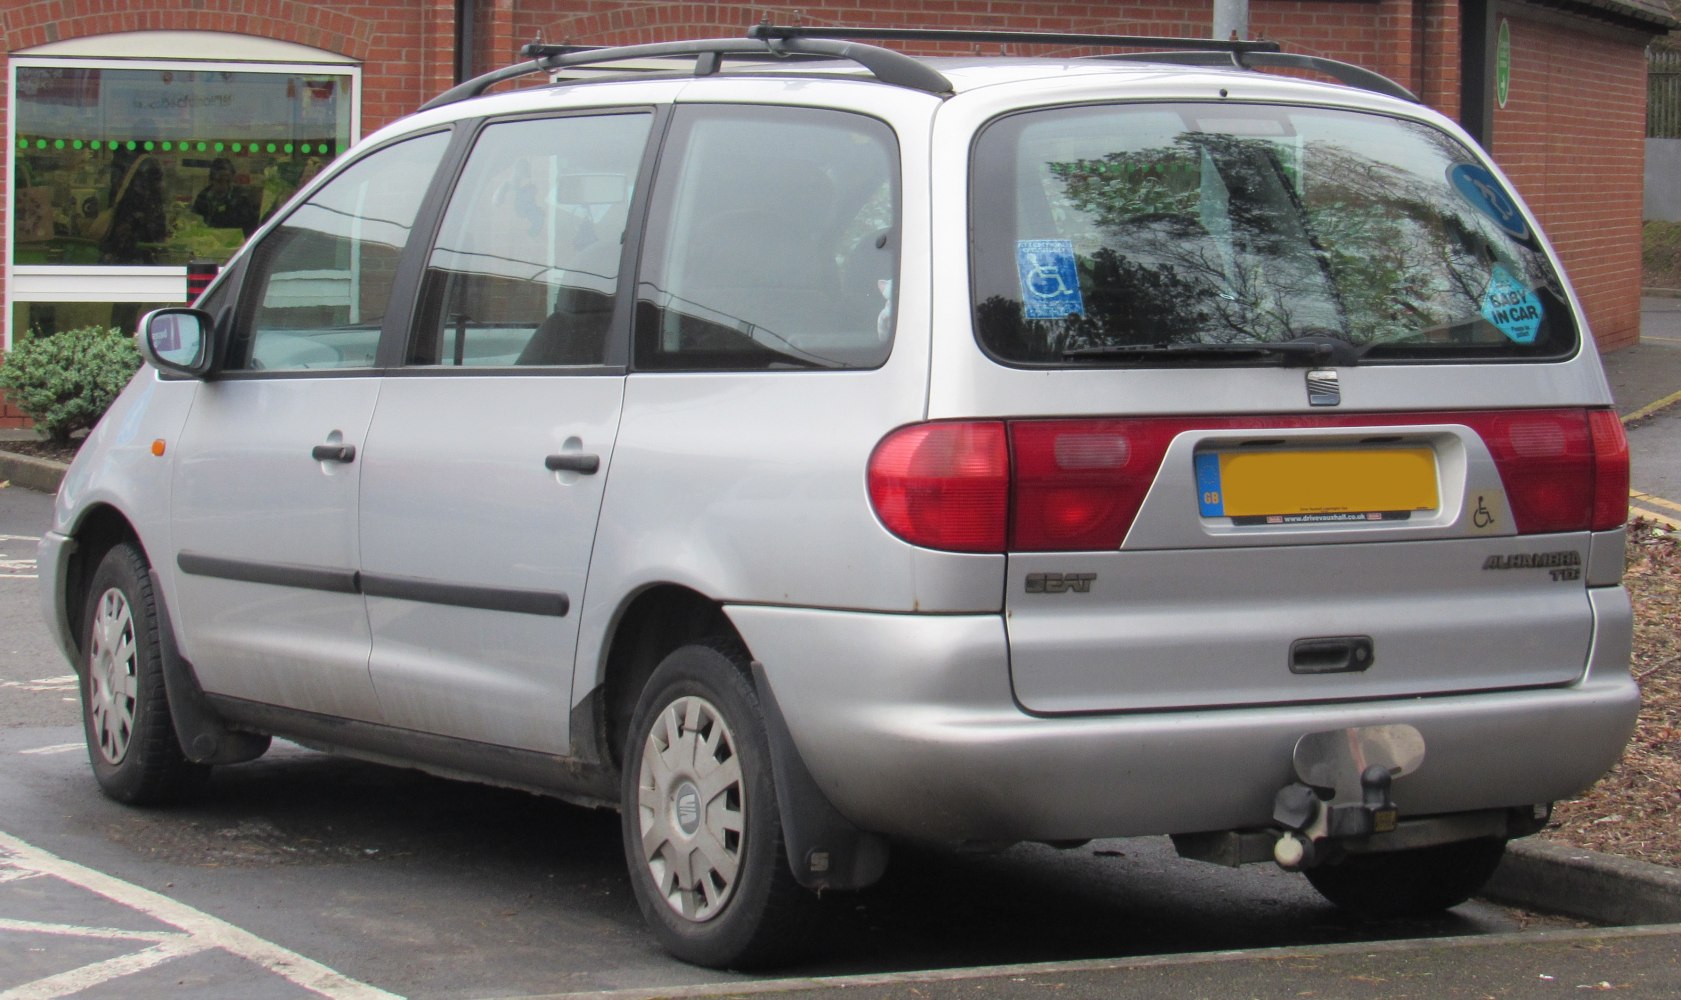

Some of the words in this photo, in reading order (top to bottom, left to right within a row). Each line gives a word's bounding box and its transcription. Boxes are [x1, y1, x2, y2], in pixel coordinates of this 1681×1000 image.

[1488, 290, 1527, 307] BABY
[1491, 309, 1509, 324] IN
[1509, 305, 1539, 322] CAR
[1204, 491, 1219, 505] GB
[1284, 513, 1366, 522] www.drivevauxhall.co.uk
[1482, 550, 1582, 570] ALHAMBRA
[1025, 572, 1098, 593] SEAT
